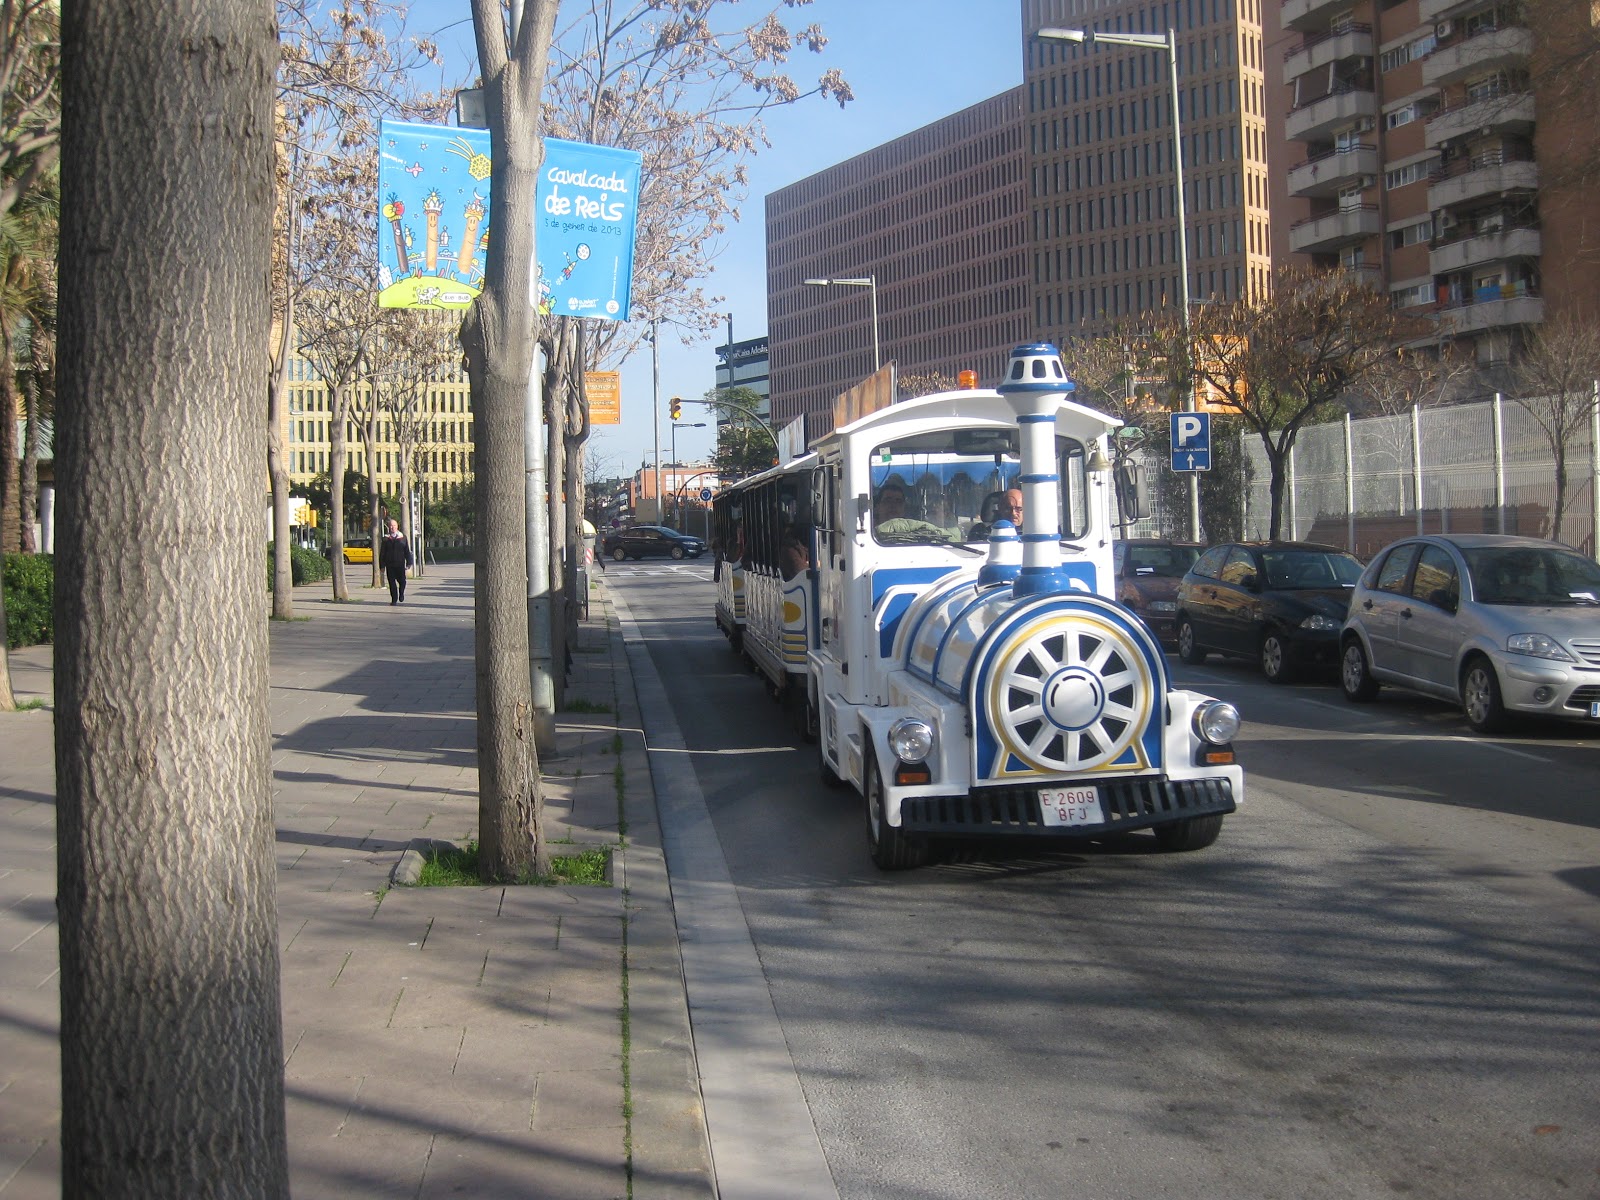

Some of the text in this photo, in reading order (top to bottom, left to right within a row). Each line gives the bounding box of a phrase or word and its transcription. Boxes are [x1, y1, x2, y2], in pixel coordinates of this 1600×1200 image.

[547, 167, 628, 193] Cavalcada
[545, 184, 625, 221] de Reis
[550, 218, 559, 228] de
[588, 222, 598, 232] de
[1178, 416, 1202, 447] P
[1043, 790, 1095, 806] E 2609
[1058, 808, 1088, 822] BFJ
